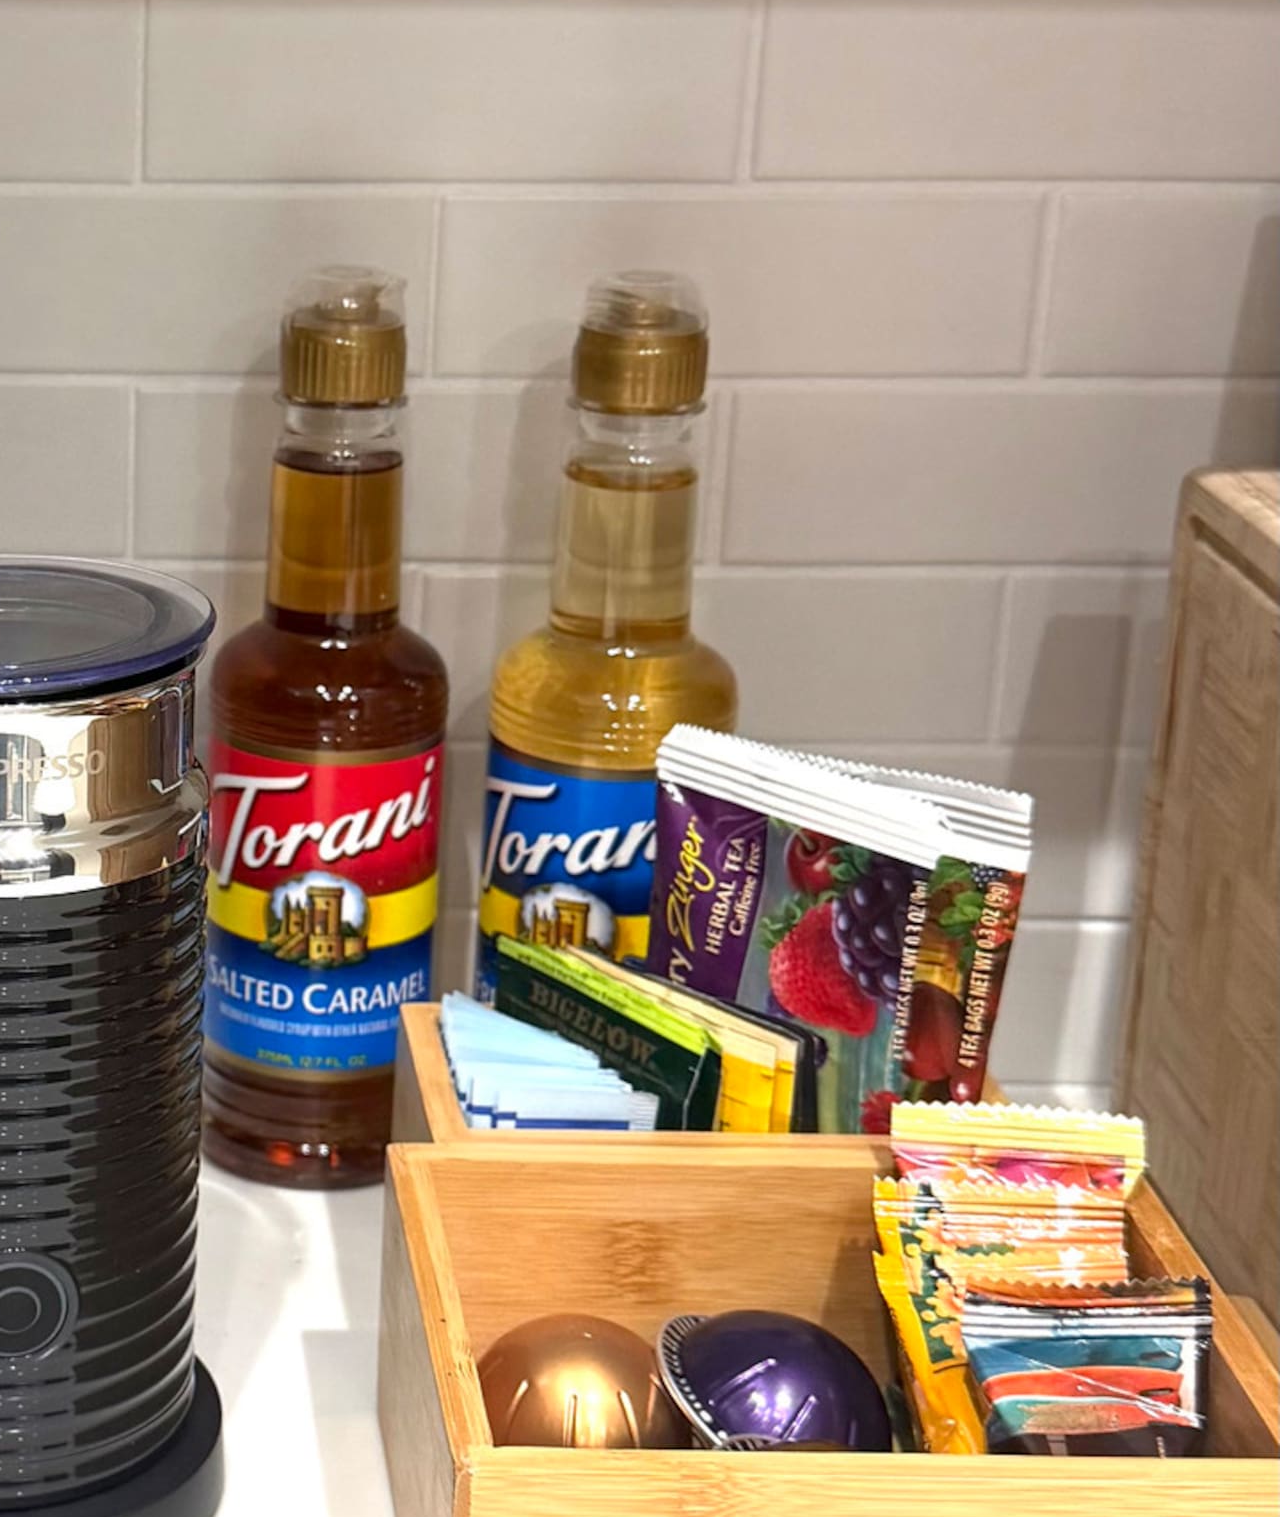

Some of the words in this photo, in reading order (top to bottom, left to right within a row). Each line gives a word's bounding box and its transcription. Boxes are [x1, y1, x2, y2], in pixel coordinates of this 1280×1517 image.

[213, 755, 436, 887] Torani
[482, 776, 657, 888] Toran
[667, 821, 715, 952] Zinger
[704, 880, 737, 955] HERBAL
[723, 837, 745, 873] TEA
[729, 874, 757, 936] Caffeine
[745, 842, 762, 874] Free
[980, 907, 1001, 927] OZ
[207, 954, 294, 1011] SALTED
[301, 968, 426, 1015] CARAMEL
[969, 972, 992, 999] NET
[973, 950, 995, 973] WT
[529, 980, 657, 1066] BIGELOW
[960, 1032, 984, 1057] TEA
[964, 997, 988, 1033] BAGS
